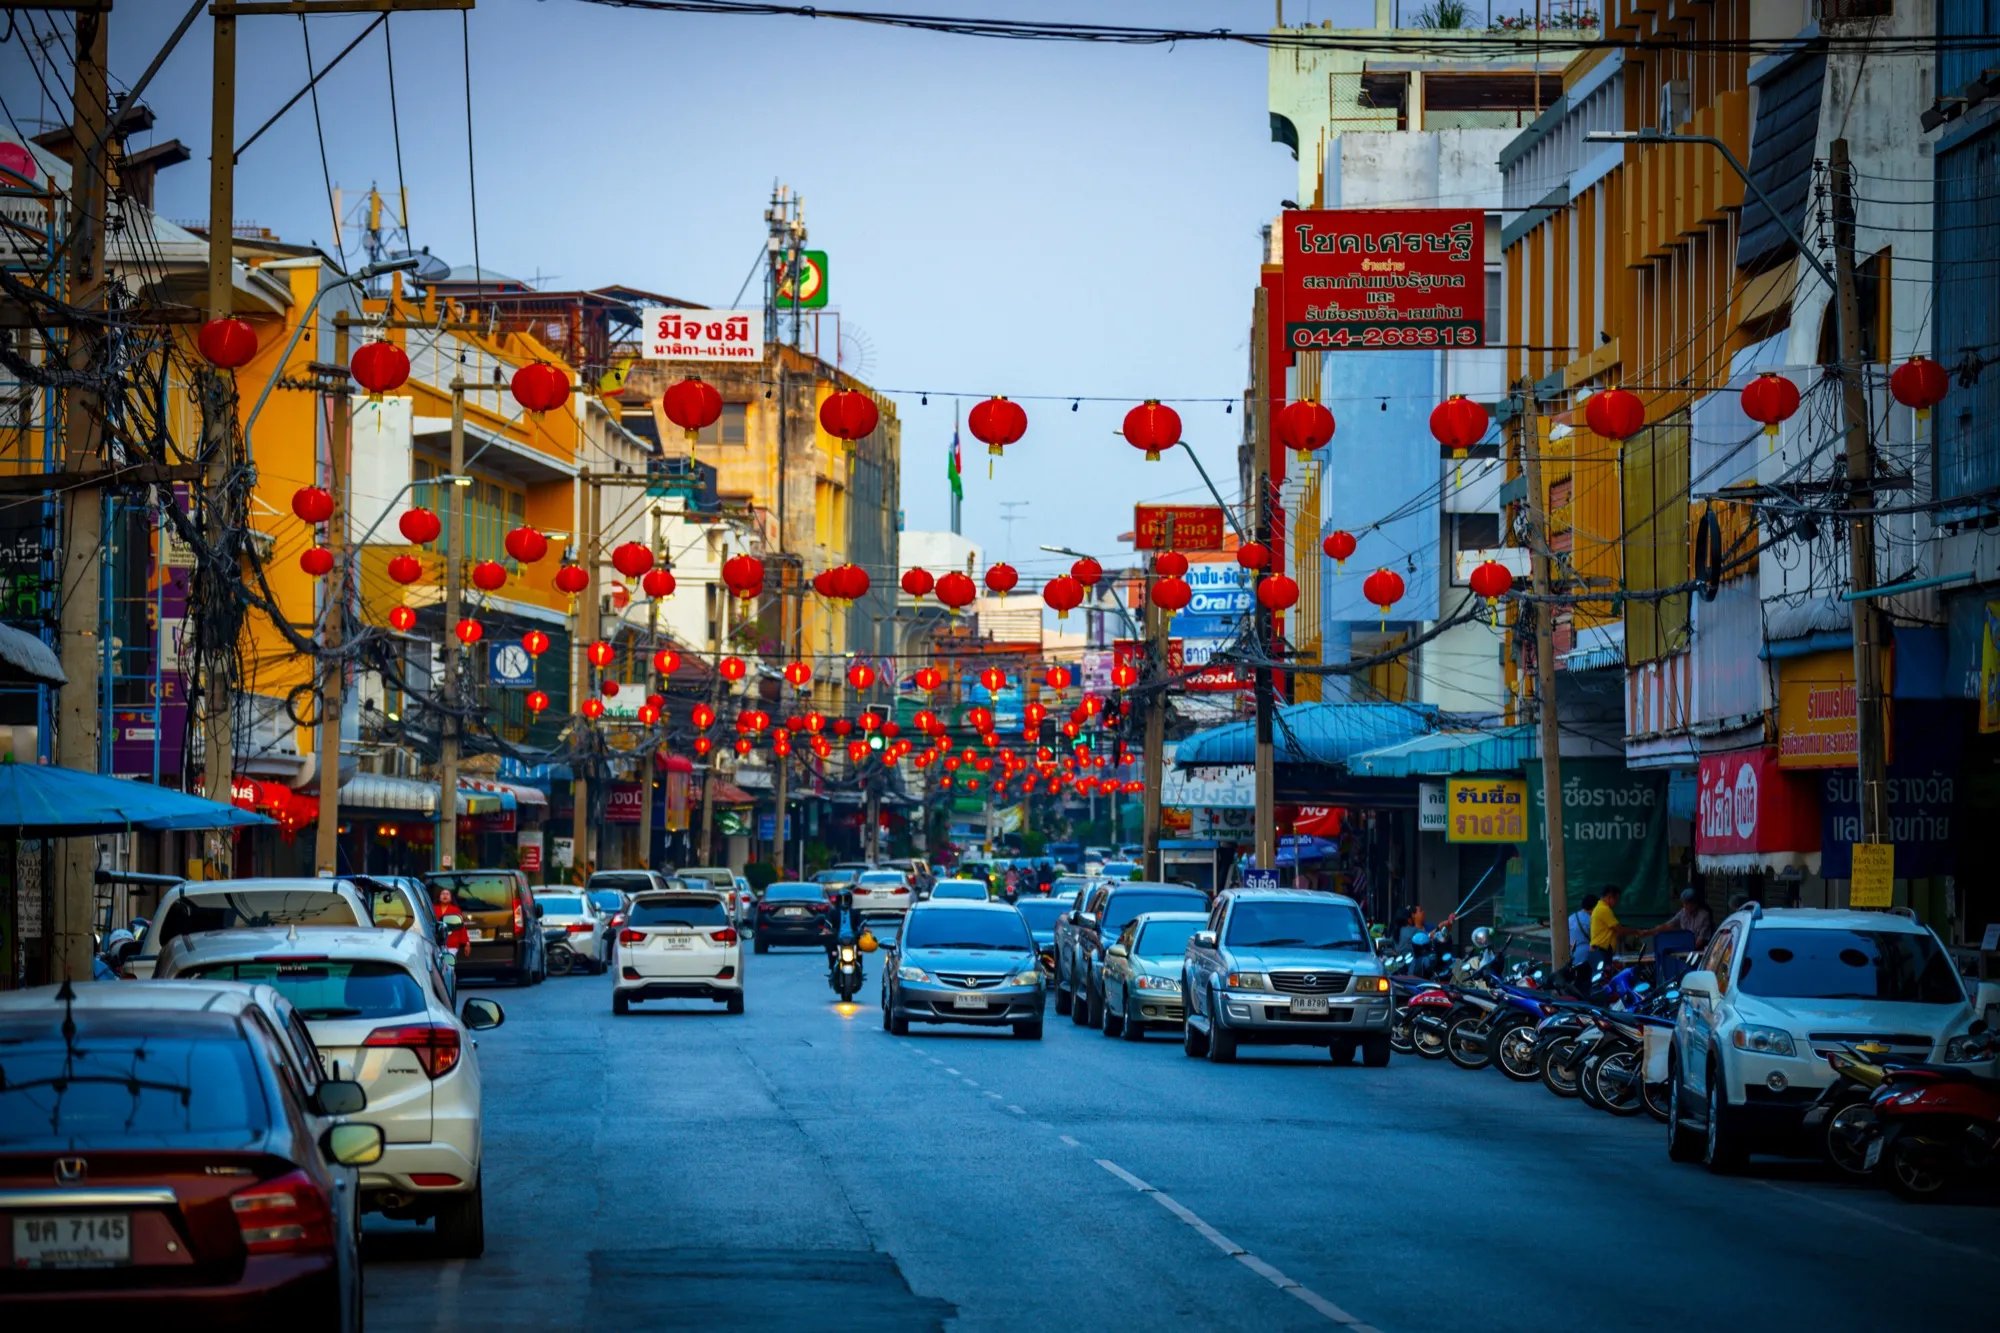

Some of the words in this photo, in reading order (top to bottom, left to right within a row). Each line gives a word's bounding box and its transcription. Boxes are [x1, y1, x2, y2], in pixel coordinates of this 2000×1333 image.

[1295, 221, 1473, 261] โชคเศรษฐี
[1303, 271, 1465, 294] สลากกินแบ่งรัฐบาล
[1367, 292, 1395, 303] และ
[657, 314, 749, 342] มีจงมี
[1293, 327, 1476, 347] 044-268313
[1457, 784, 1521, 804] รับซื้อ
[1456, 807, 1521, 836] รางวัล
[1575, 814, 1647, 841] เลขท้าย
[70, 1219, 124, 1241] 7145
